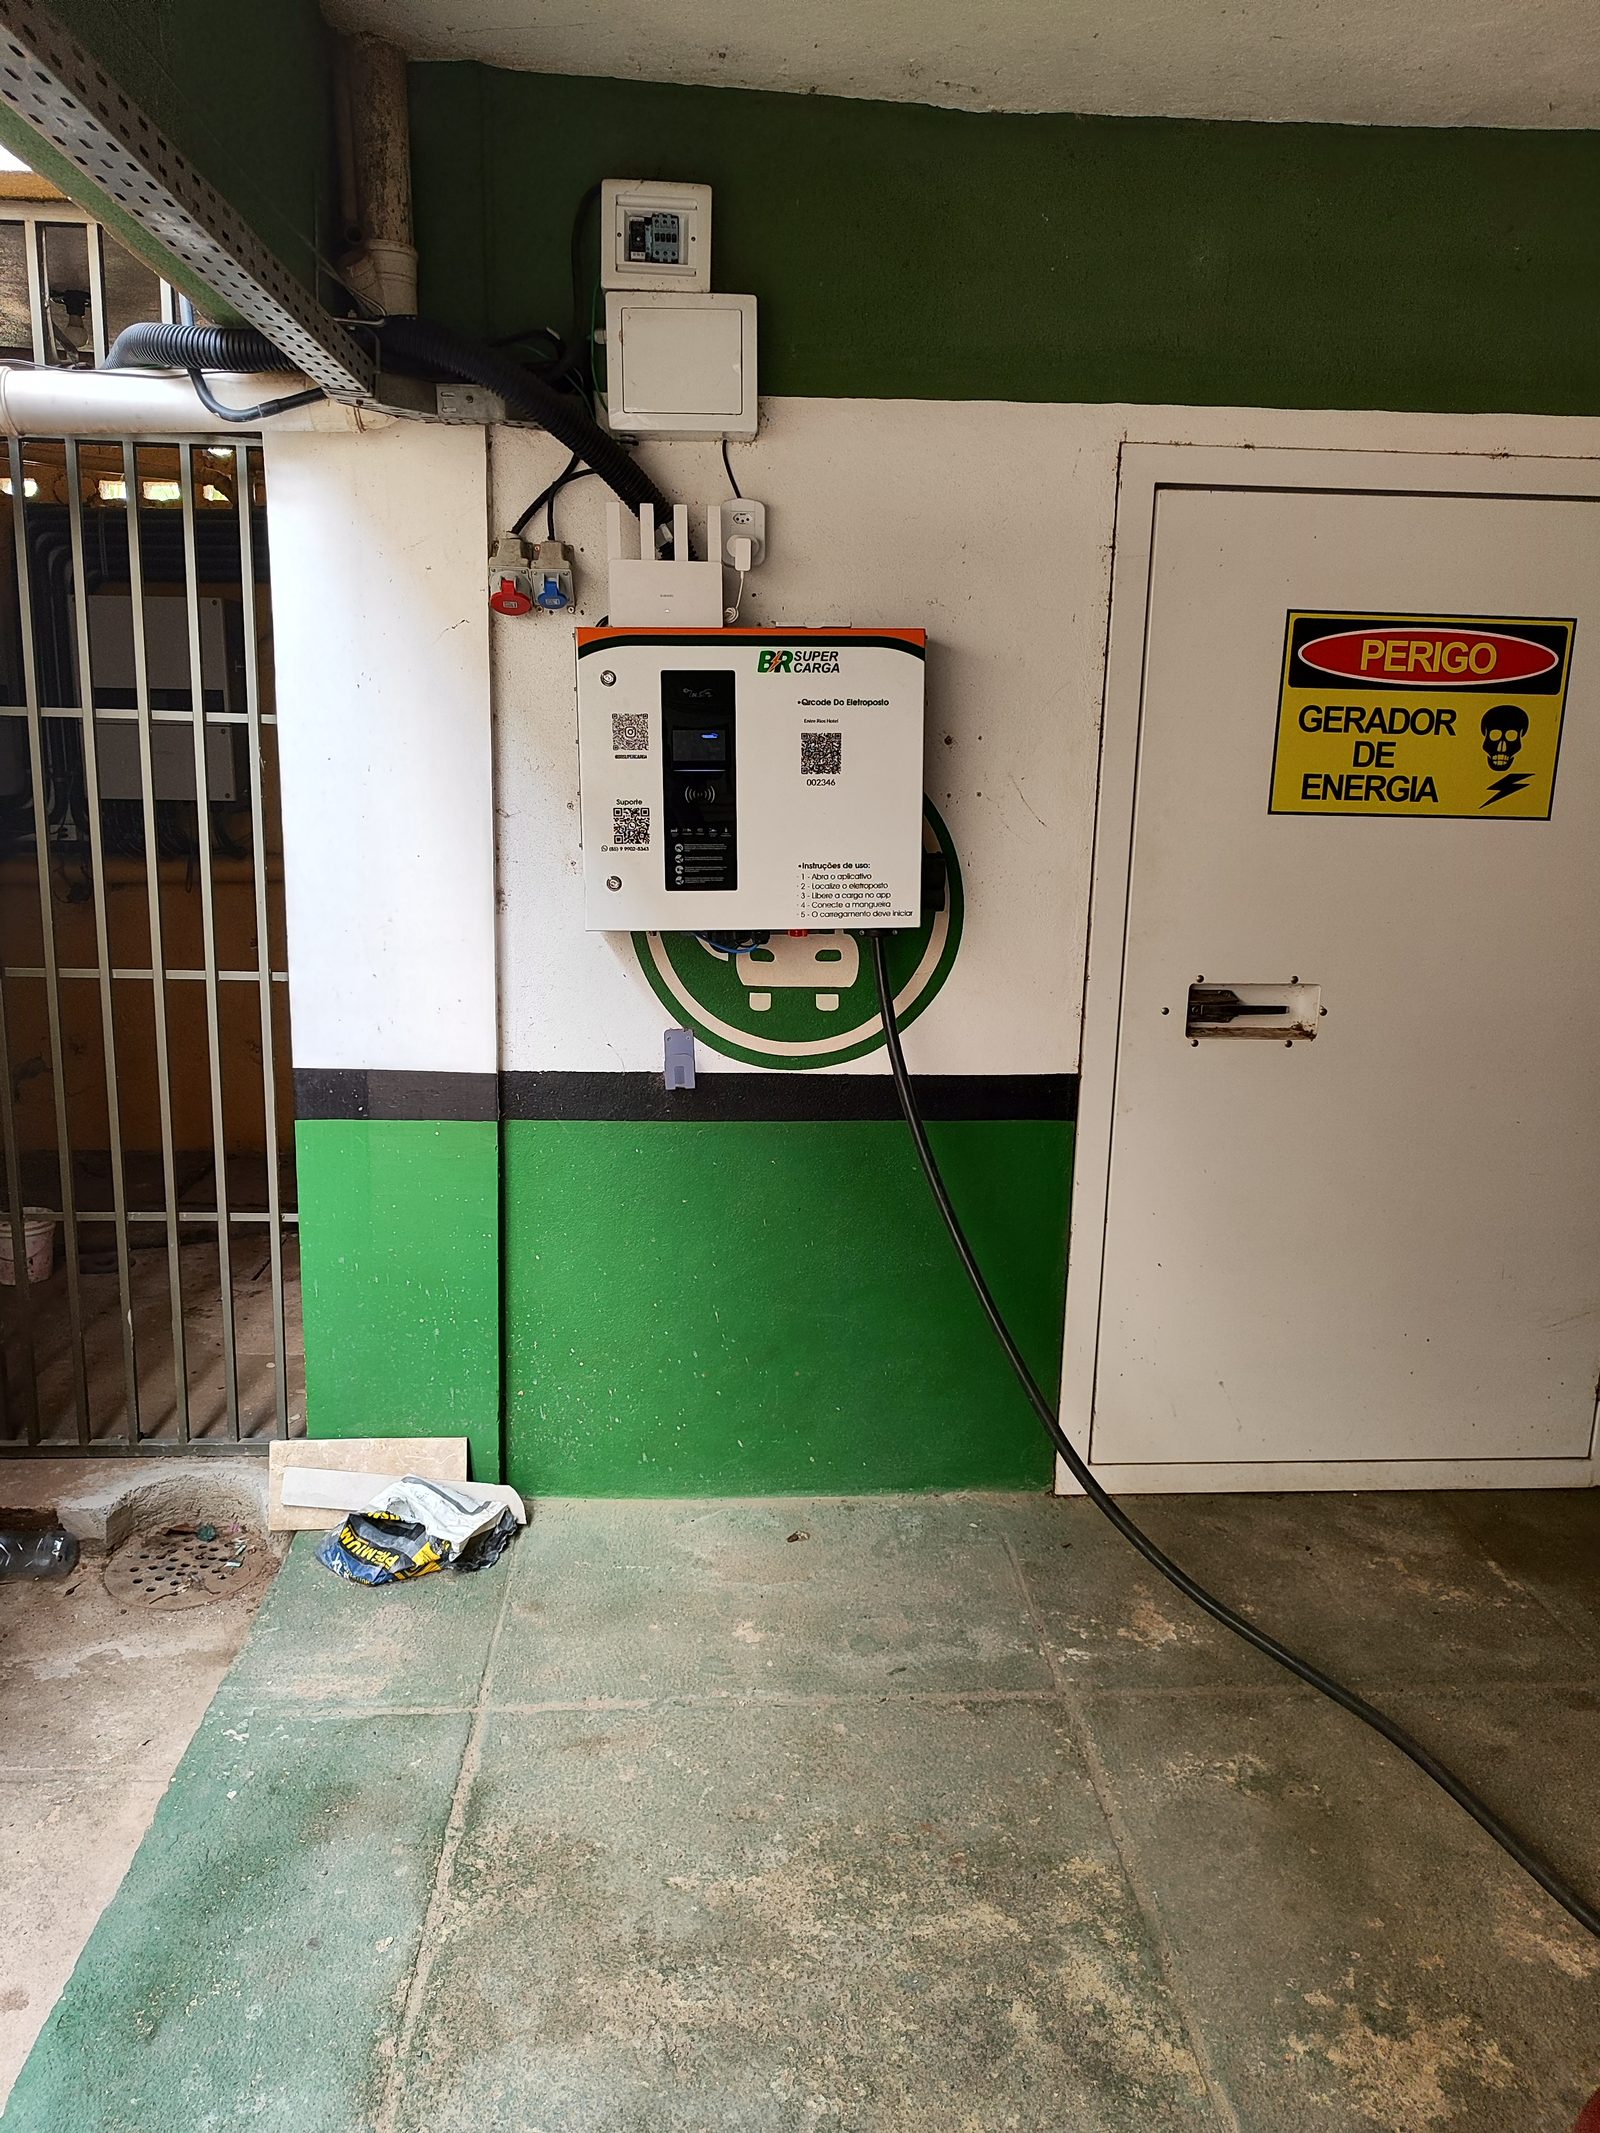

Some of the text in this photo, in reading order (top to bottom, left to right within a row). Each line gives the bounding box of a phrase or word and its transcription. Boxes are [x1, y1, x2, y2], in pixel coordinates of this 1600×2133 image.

[794, 651, 839, 662] SUPER
[1360, 639, 1497, 675] PERIGO
[757, 650, 793, 673] BR
[794, 663, 840, 673] CARGA
[846, 699, 890, 707] Eletroposto
[1298, 705, 1457, 736] GERADOR
[1352, 740, 1397, 769] DE
[1301, 773, 1439, 803] ENERGIA
[802, 862, 841, 871] Instruções
[837, 873, 872, 881] aplicativo
[848, 882, 888, 890] eletroposto
[876, 892, 891, 900] app
[811, 901, 844, 909] Conecte
[851, 901, 891, 909] mangueira
[819, 911, 871, 919] carregamento
